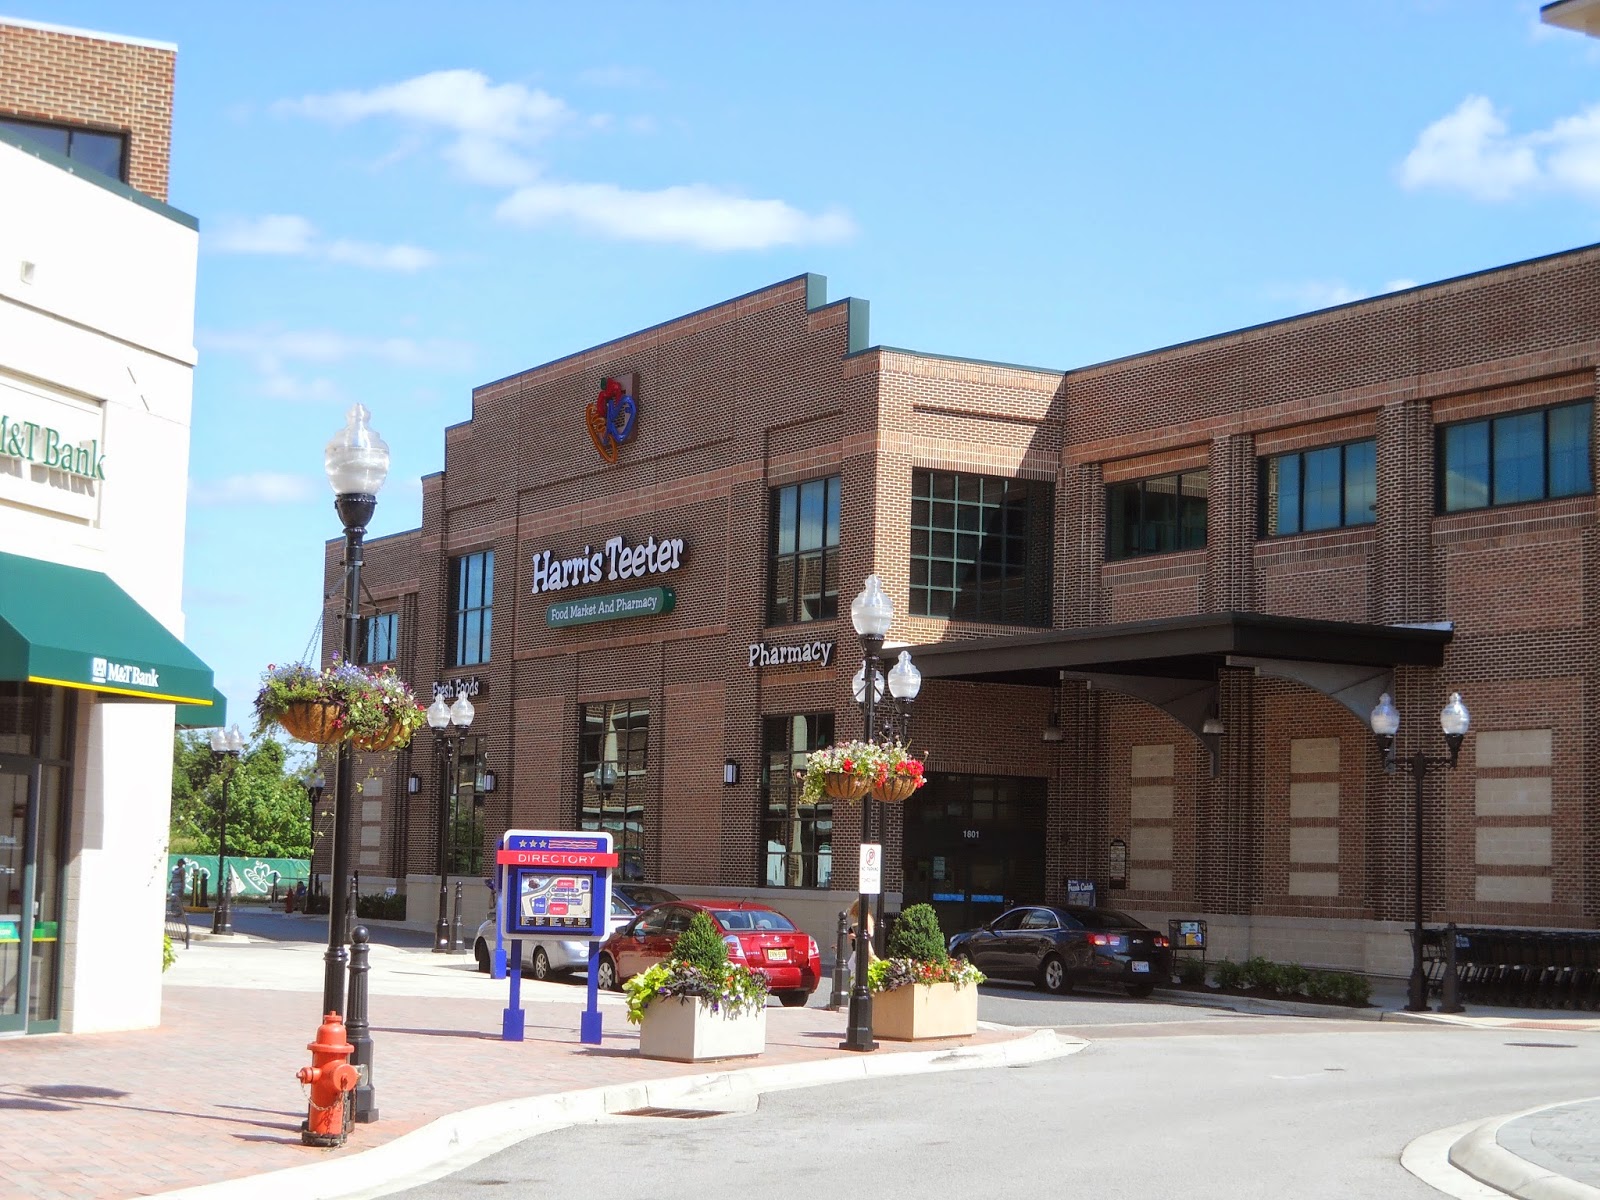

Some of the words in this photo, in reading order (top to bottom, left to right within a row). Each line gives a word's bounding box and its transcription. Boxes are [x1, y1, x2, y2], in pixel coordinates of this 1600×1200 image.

[43, 427, 106, 480] Bank
[532, 545, 602, 594] Harris
[606, 536, 684, 581] Teeter
[551, 607, 569, 621] Food
[570, 603, 597, 619] Market
[598, 600, 614, 614] And
[616, 597, 658, 612] Pharmacy
[748, 641, 832, 667] Pharmacy
[107, 662, 132, 684] M&T
[131, 666, 159, 687] Bank
[432, 680, 454, 700] Fresh
[455, 676, 479, 698] Foods
[962, 830, 980, 839] 1801
[518, 853, 596, 865] DIRECTORY
